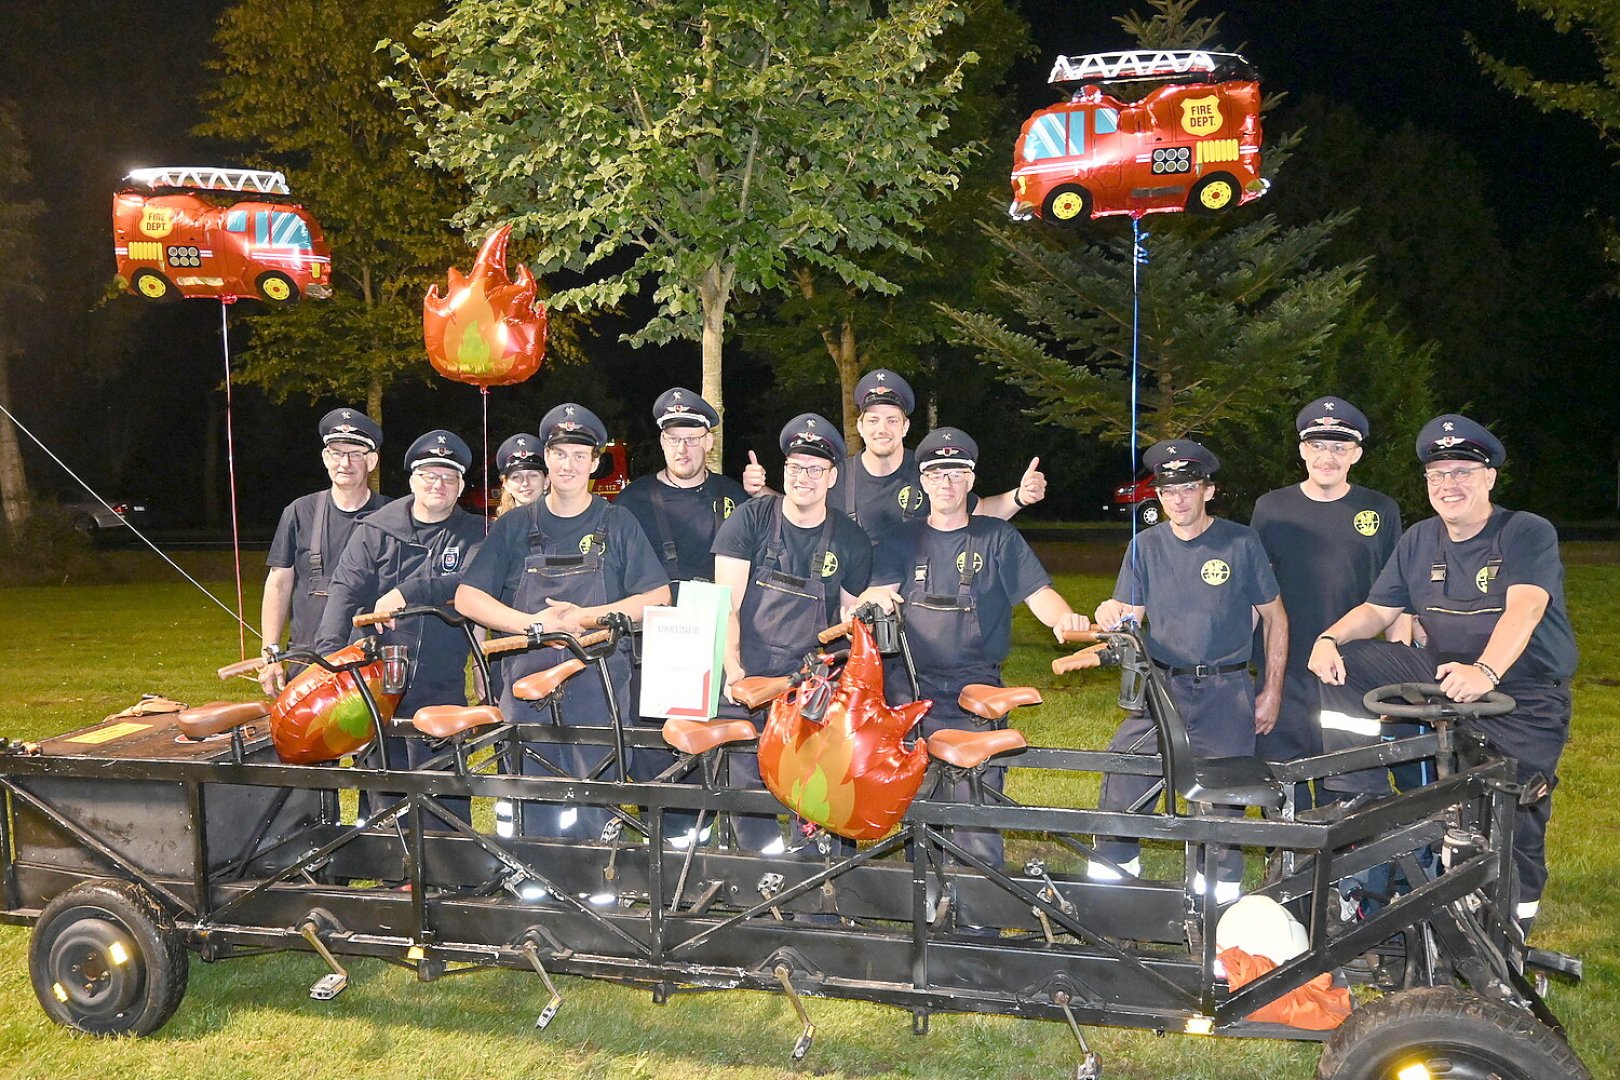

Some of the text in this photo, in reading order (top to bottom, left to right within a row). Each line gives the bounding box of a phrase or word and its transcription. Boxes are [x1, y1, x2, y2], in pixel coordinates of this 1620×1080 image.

[1191, 104, 1213, 115] FIRE
[1190, 115, 1216, 128] DEPT.
[148, 212, 165, 222] FIRE
[146, 222, 167, 232] DEPT.
[658, 624, 700, 635] URKUNDE
